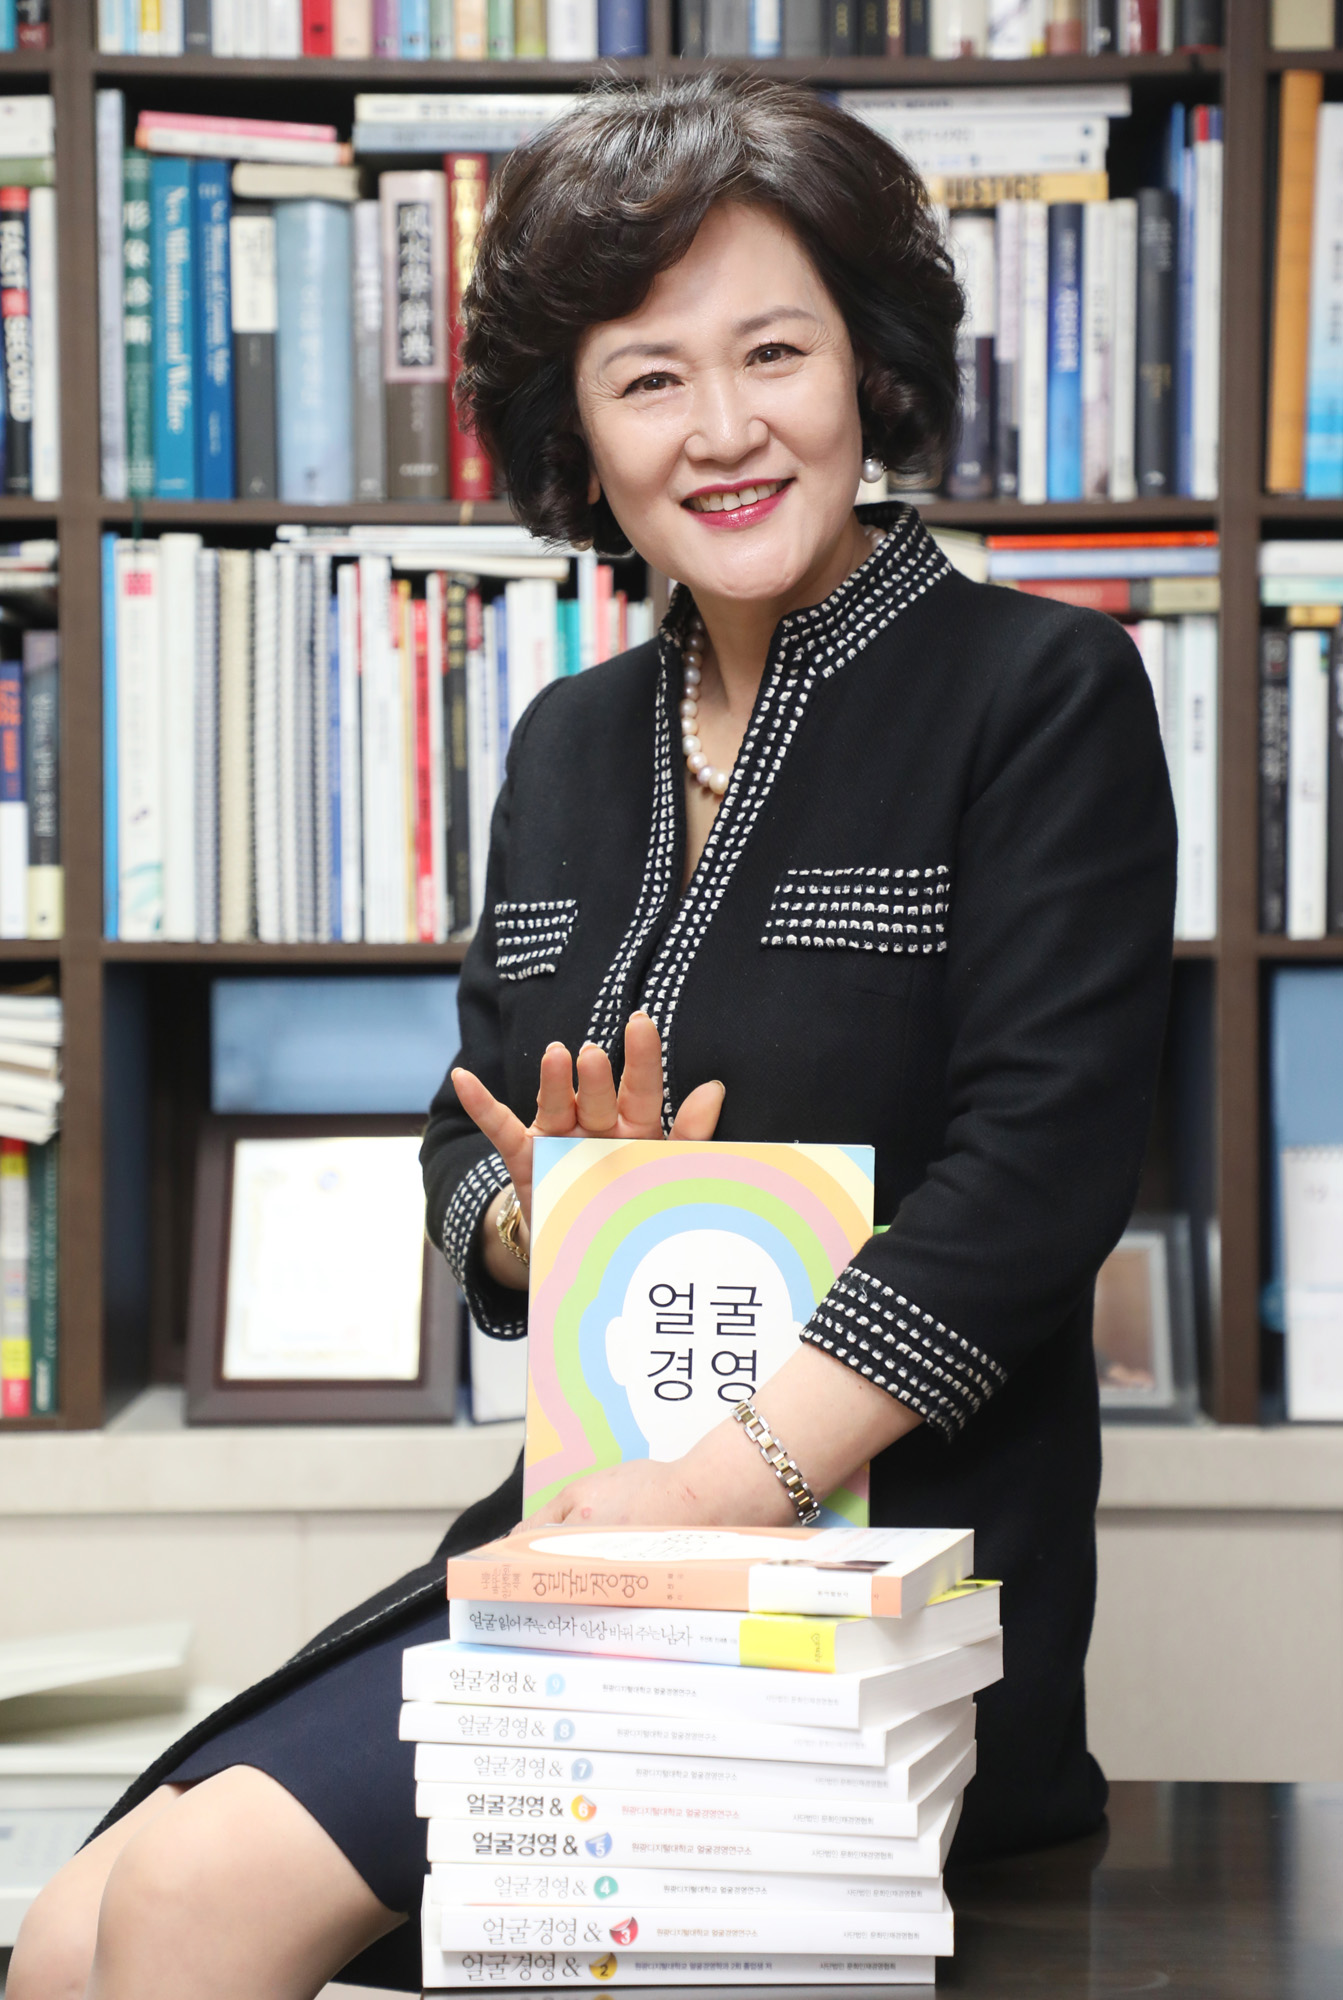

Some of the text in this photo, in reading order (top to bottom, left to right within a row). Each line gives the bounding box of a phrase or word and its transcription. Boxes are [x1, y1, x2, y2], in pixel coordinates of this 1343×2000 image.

[648, 1283, 763, 1336] 얼굴
[647, 1348, 758, 1403] 경영
[532, 1568, 649, 1599] 얼굴경영
[469, 1611, 693, 1647] 얼굴 읽어 주는 여자 인상 바꿔 주는 남자
[449, 1669, 518, 1694] 얼굴경영
[522, 1675, 537, 1693] &
[552, 1678, 560, 1692] 9
[457, 1715, 529, 1739] 얼굴경영
[531, 1720, 546, 1737] &
[559, 1724, 570, 1737] 8
[473, 1755, 546, 1780] 얼굴경영
[548, 1760, 563, 1778] &
[577, 1764, 587, 1777] 7
[467, 1794, 545, 1818] 얼굴경영
[549, 1798, 564, 1817] &
[578, 1805, 589, 1818] 6
[472, 1831, 558, 1857] 얼굴경영
[563, 1835, 579, 1857] &
[596, 1842, 605, 1857] 5
[494, 1876, 570, 1899] 얼굴경영
[572, 1880, 588, 1897] &
[600, 1879, 611, 1895] 4
[482, 1917, 578, 1946] 얼굴경영
[583, 1922, 604, 1943] &
[620, 1931, 631, 1945] 3
[461, 1952, 556, 1982] 얼굴경영
[562, 1956, 583, 1978] &
[600, 1964, 609, 1977] 2
